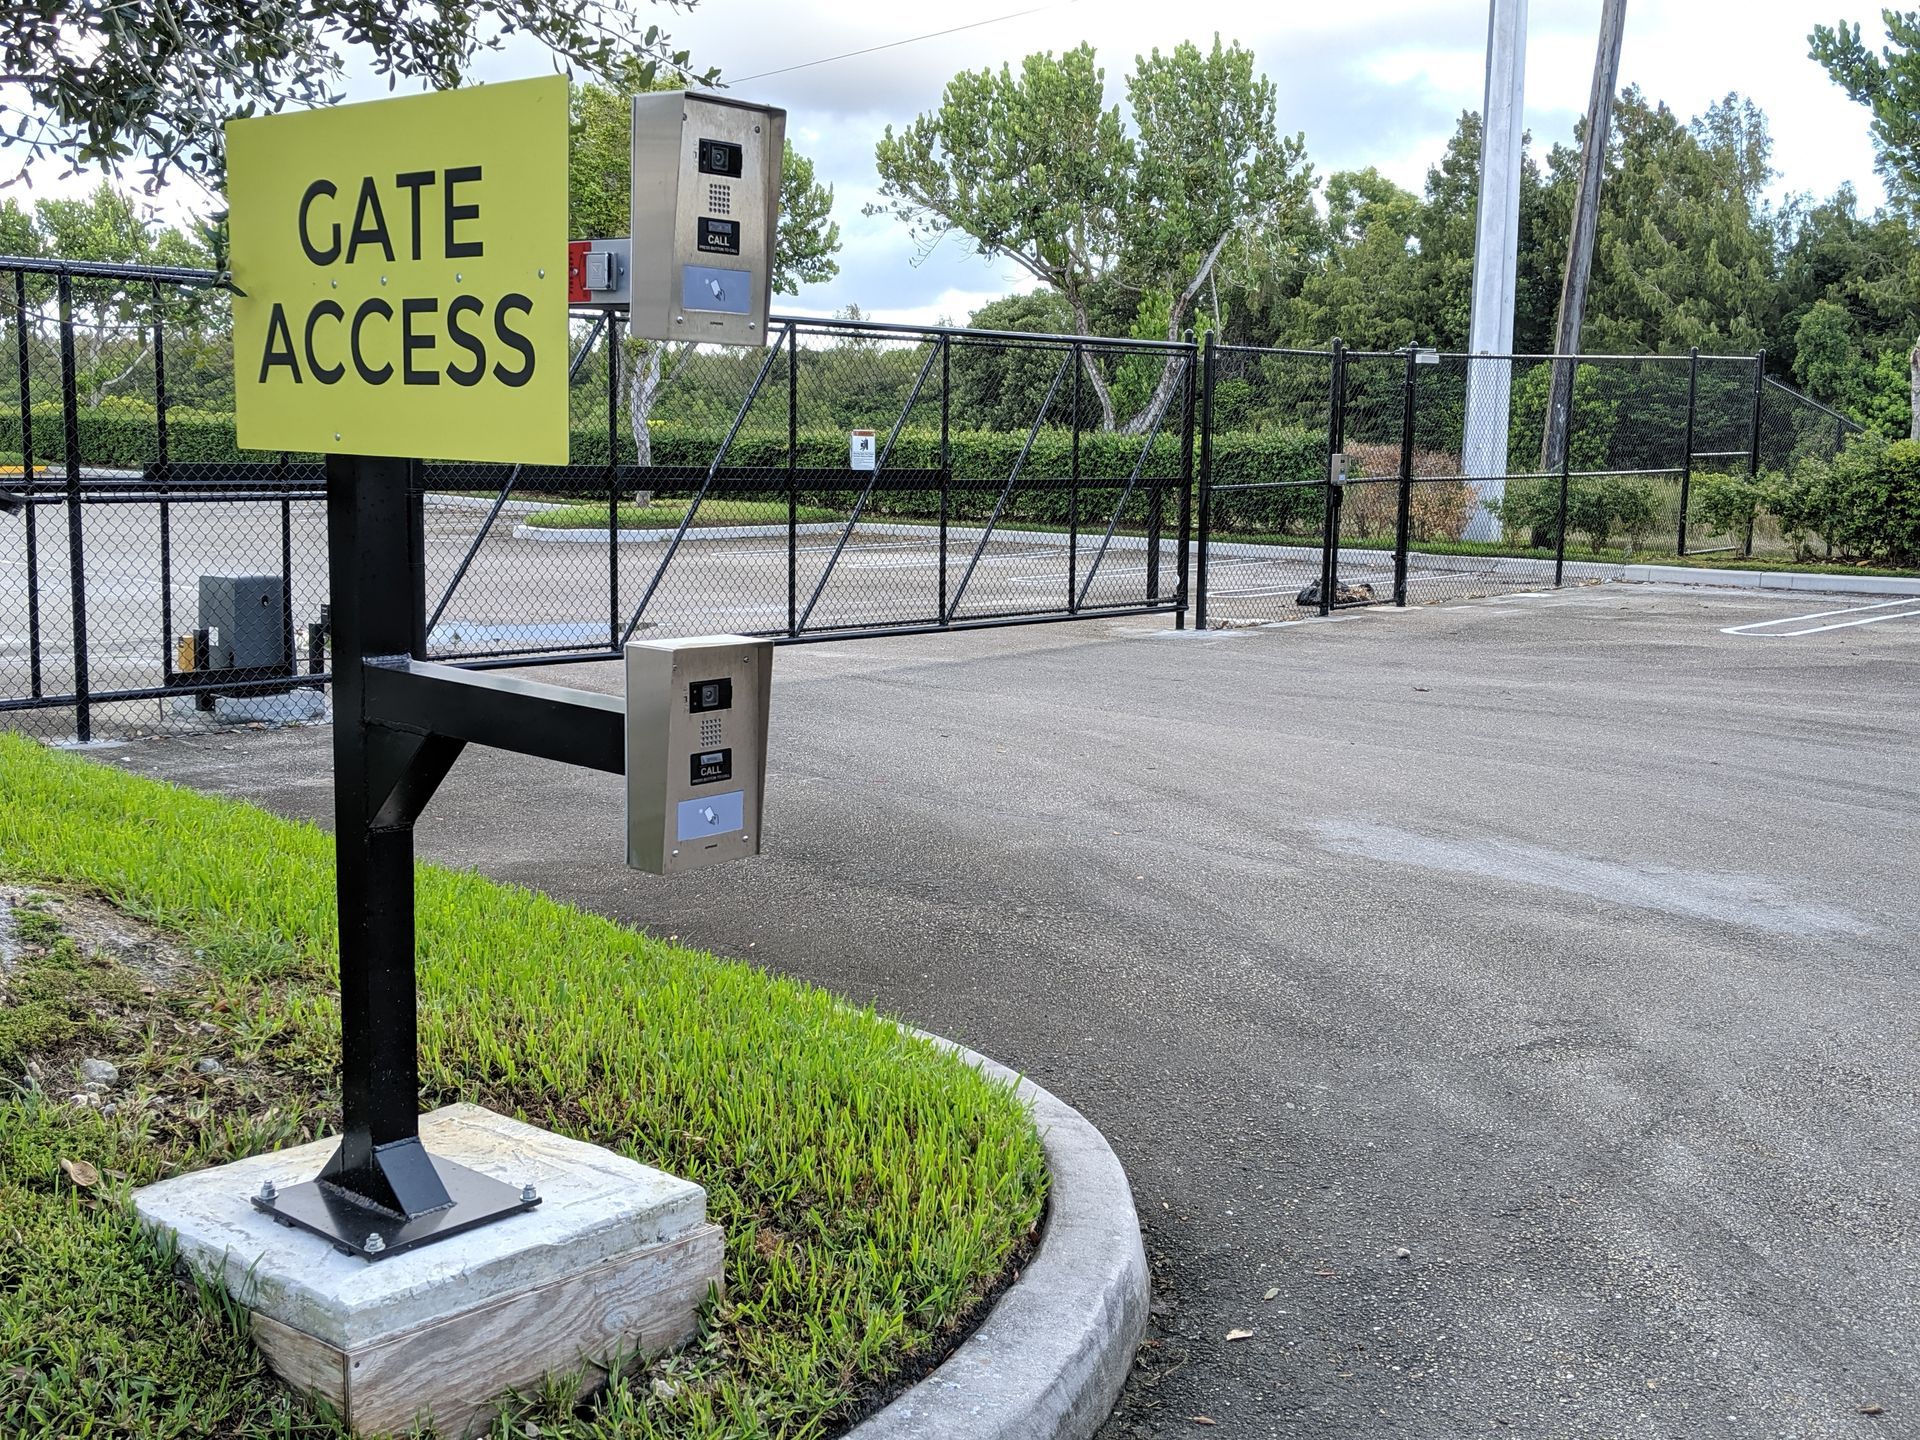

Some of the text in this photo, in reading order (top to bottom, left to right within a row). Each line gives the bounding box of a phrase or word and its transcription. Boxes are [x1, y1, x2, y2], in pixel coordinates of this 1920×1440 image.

[298, 165, 484, 267] GATE
[708, 235, 729, 246] CALL
[258, 293, 536, 388] ACCESS
[701, 766, 721, 775] CALL
